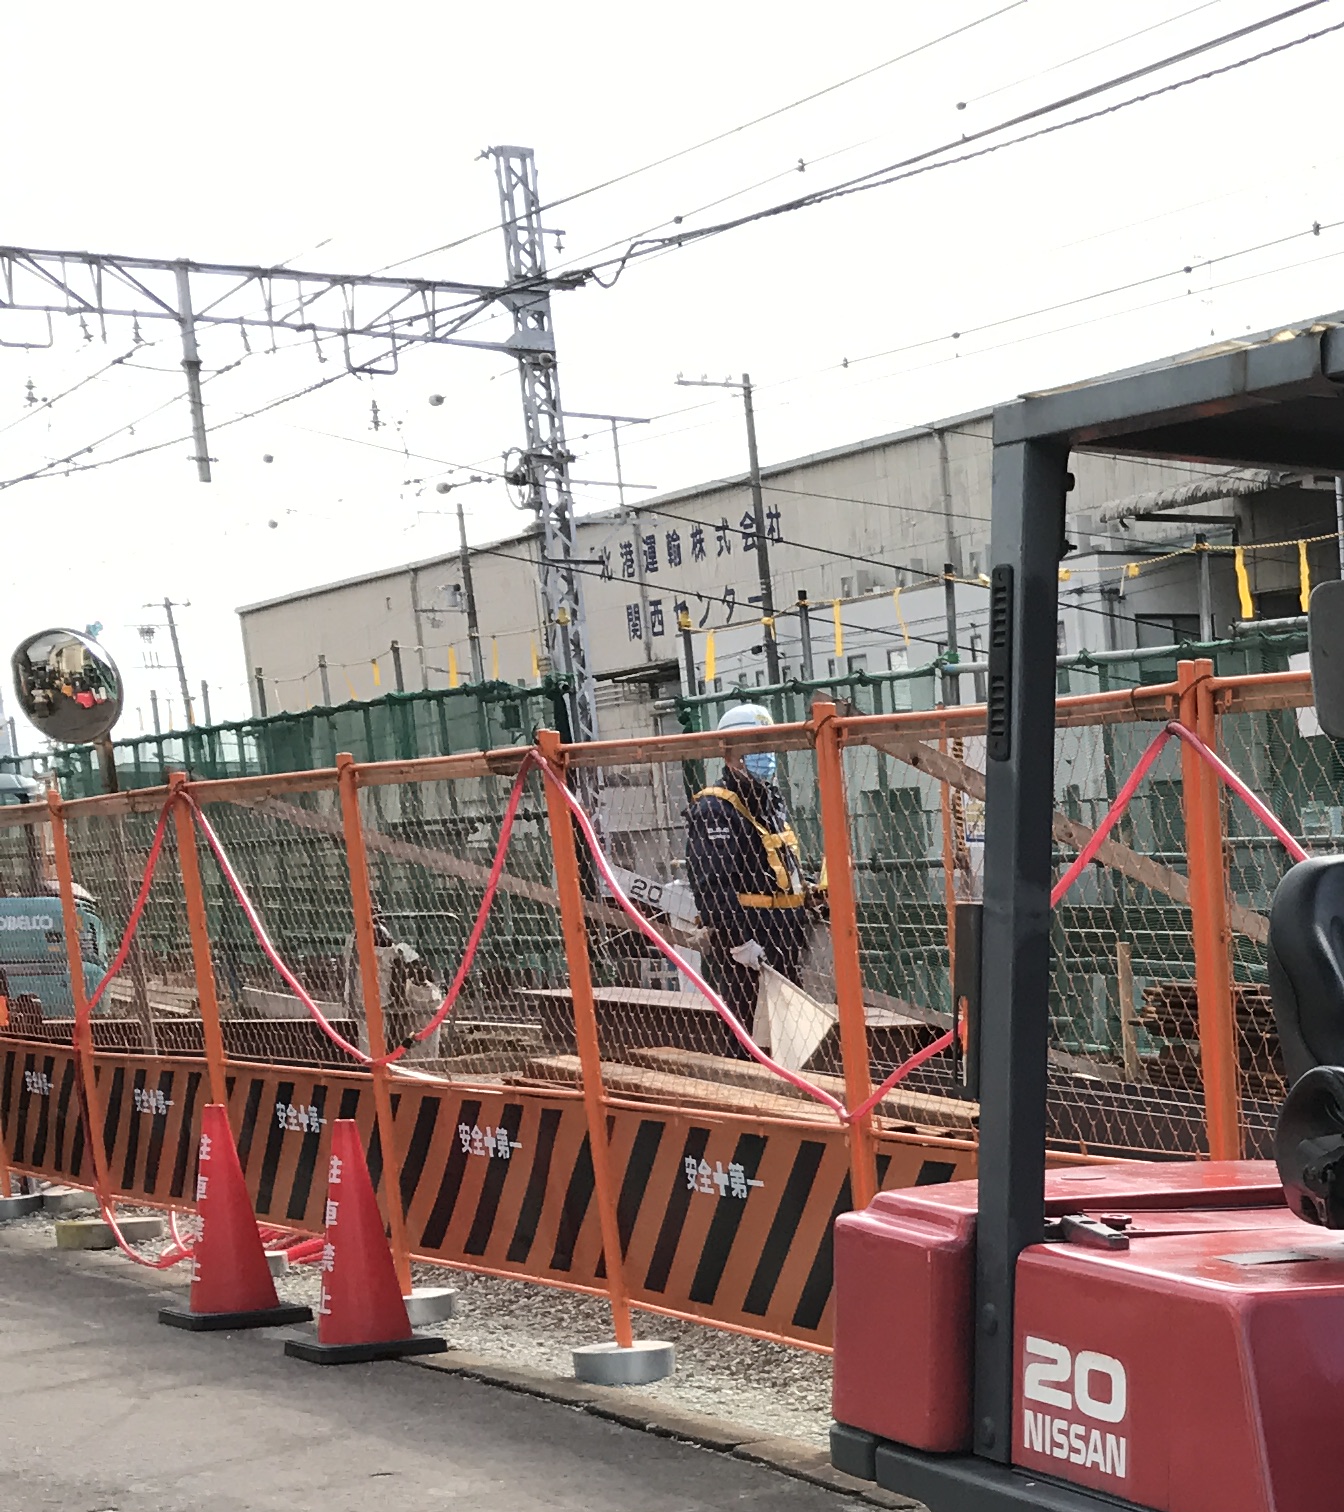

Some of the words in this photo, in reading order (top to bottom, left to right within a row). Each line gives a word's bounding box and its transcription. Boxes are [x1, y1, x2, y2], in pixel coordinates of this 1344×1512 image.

[630, 878, 663, 904] 20
[1024, 1335, 1127, 1424] 20
[1023, 1409, 1127, 1479] NISSAN
